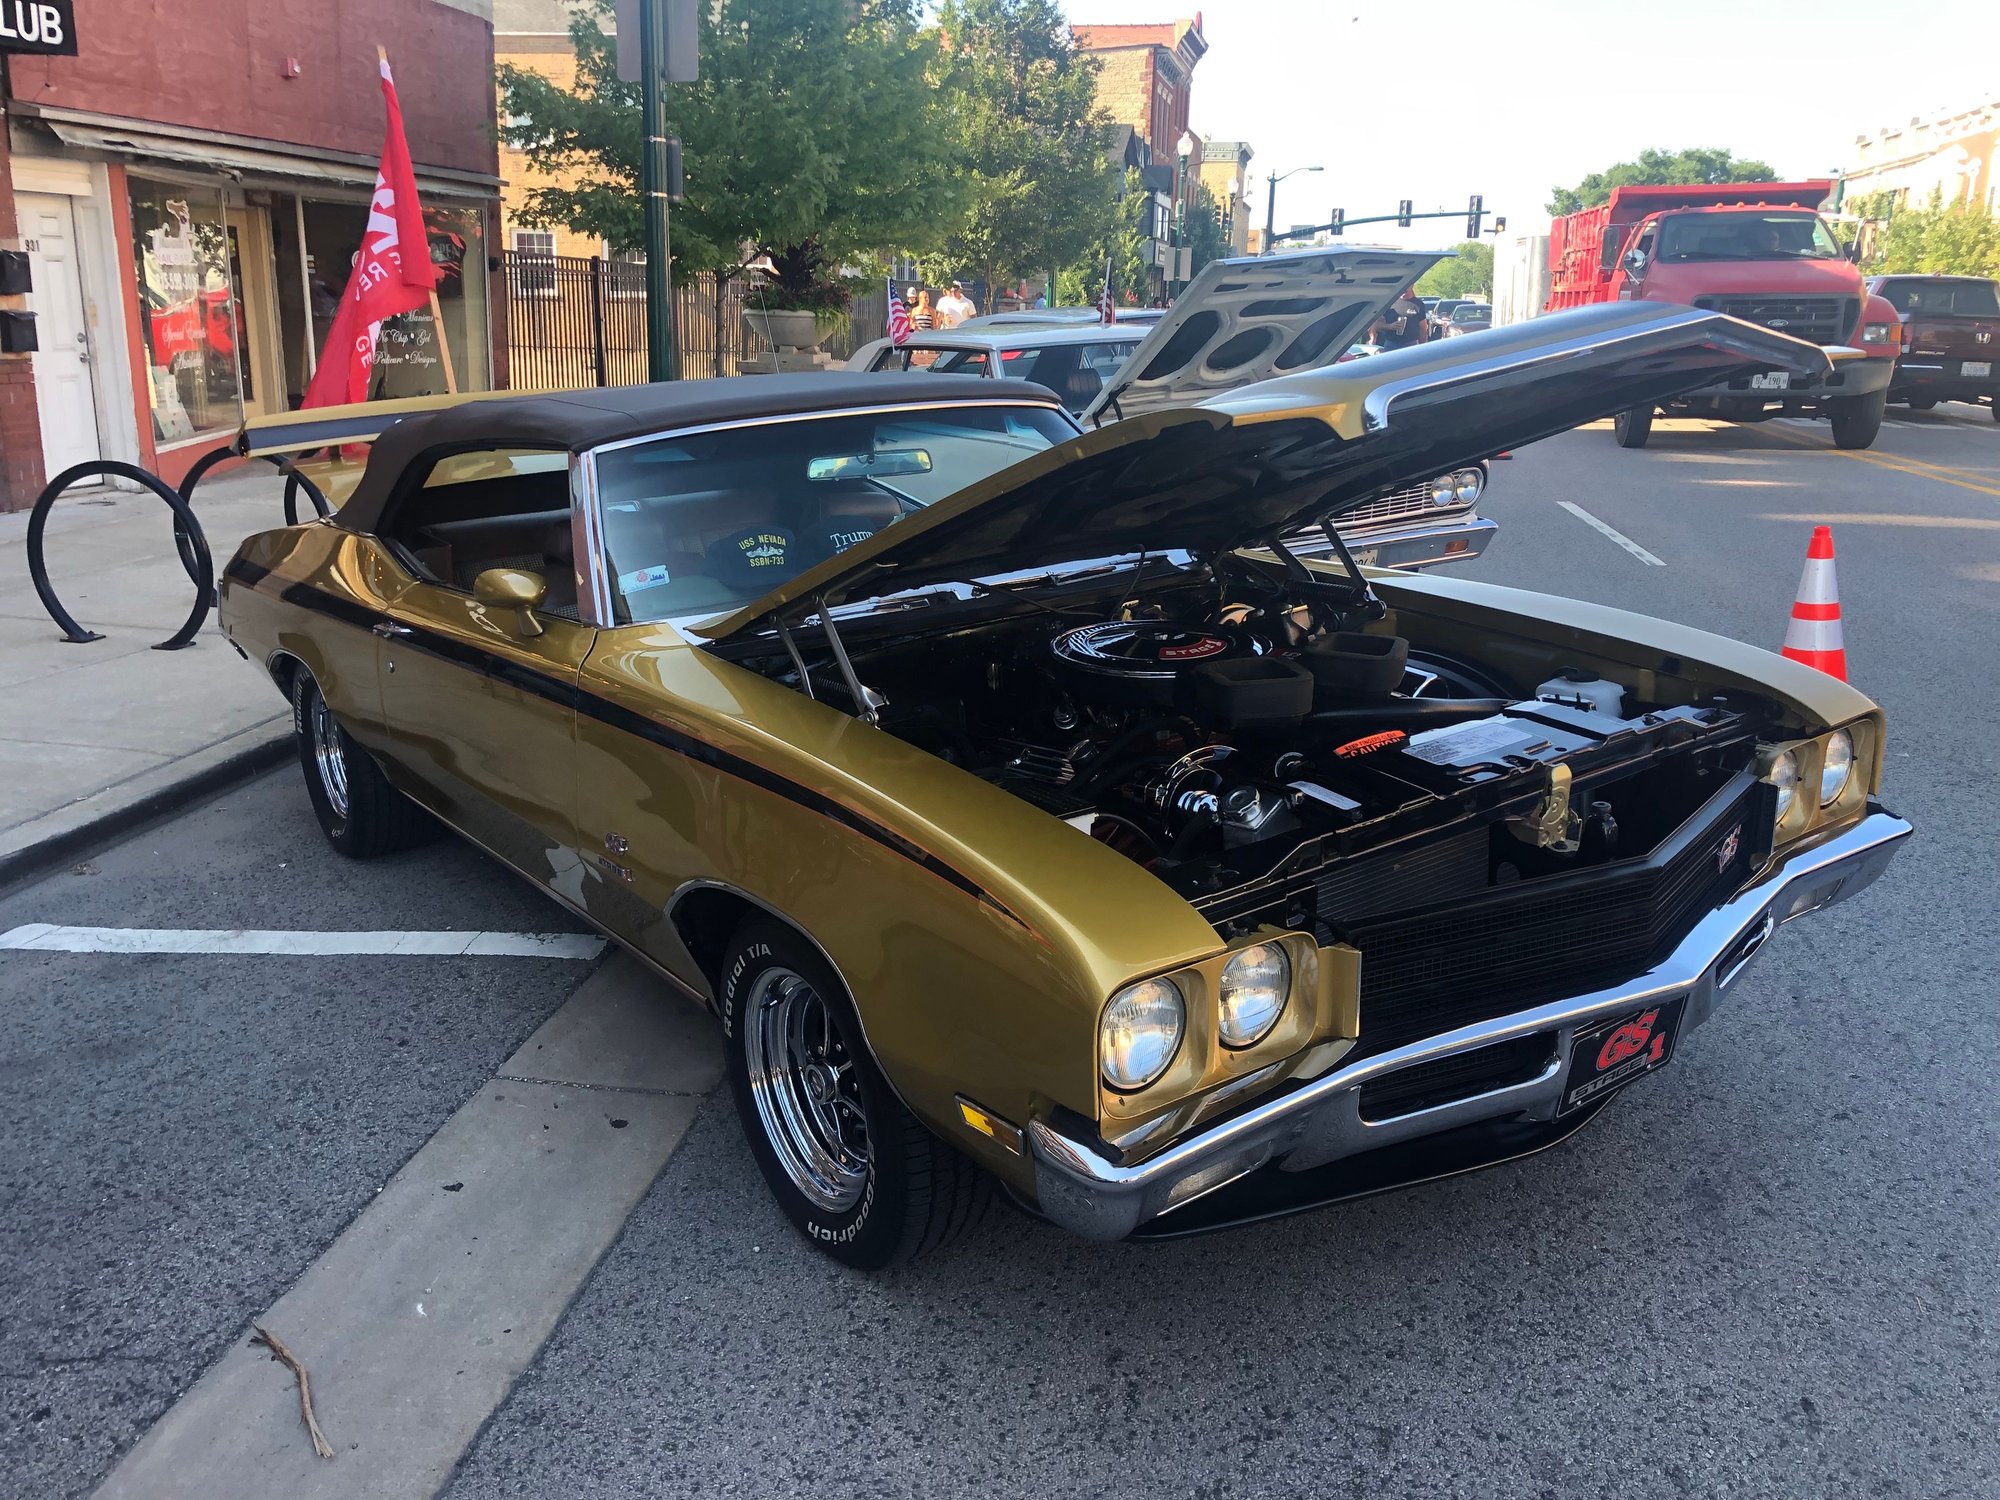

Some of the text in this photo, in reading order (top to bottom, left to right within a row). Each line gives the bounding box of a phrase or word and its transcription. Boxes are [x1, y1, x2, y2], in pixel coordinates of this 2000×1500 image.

[0, 0, 64, 45] LUB
[25, 239, 39, 251] 931
[402, 309, 433, 322] Manicur
[391, 328, 408, 347] Chip
[416, 329, 431, 346] Gel
[373, 350, 437, 369] Pedicure Designs
[738, 534, 788, 551] USS NEVADA
[749, 556, 785, 568] SSBN-733
[1165, 643, 1215, 656] STAGE
[724, 942, 773, 1039] Radial T/A
[1595, 1007, 1661, 1073] GS
[1568, 1031, 1667, 1105] STAGE 1
